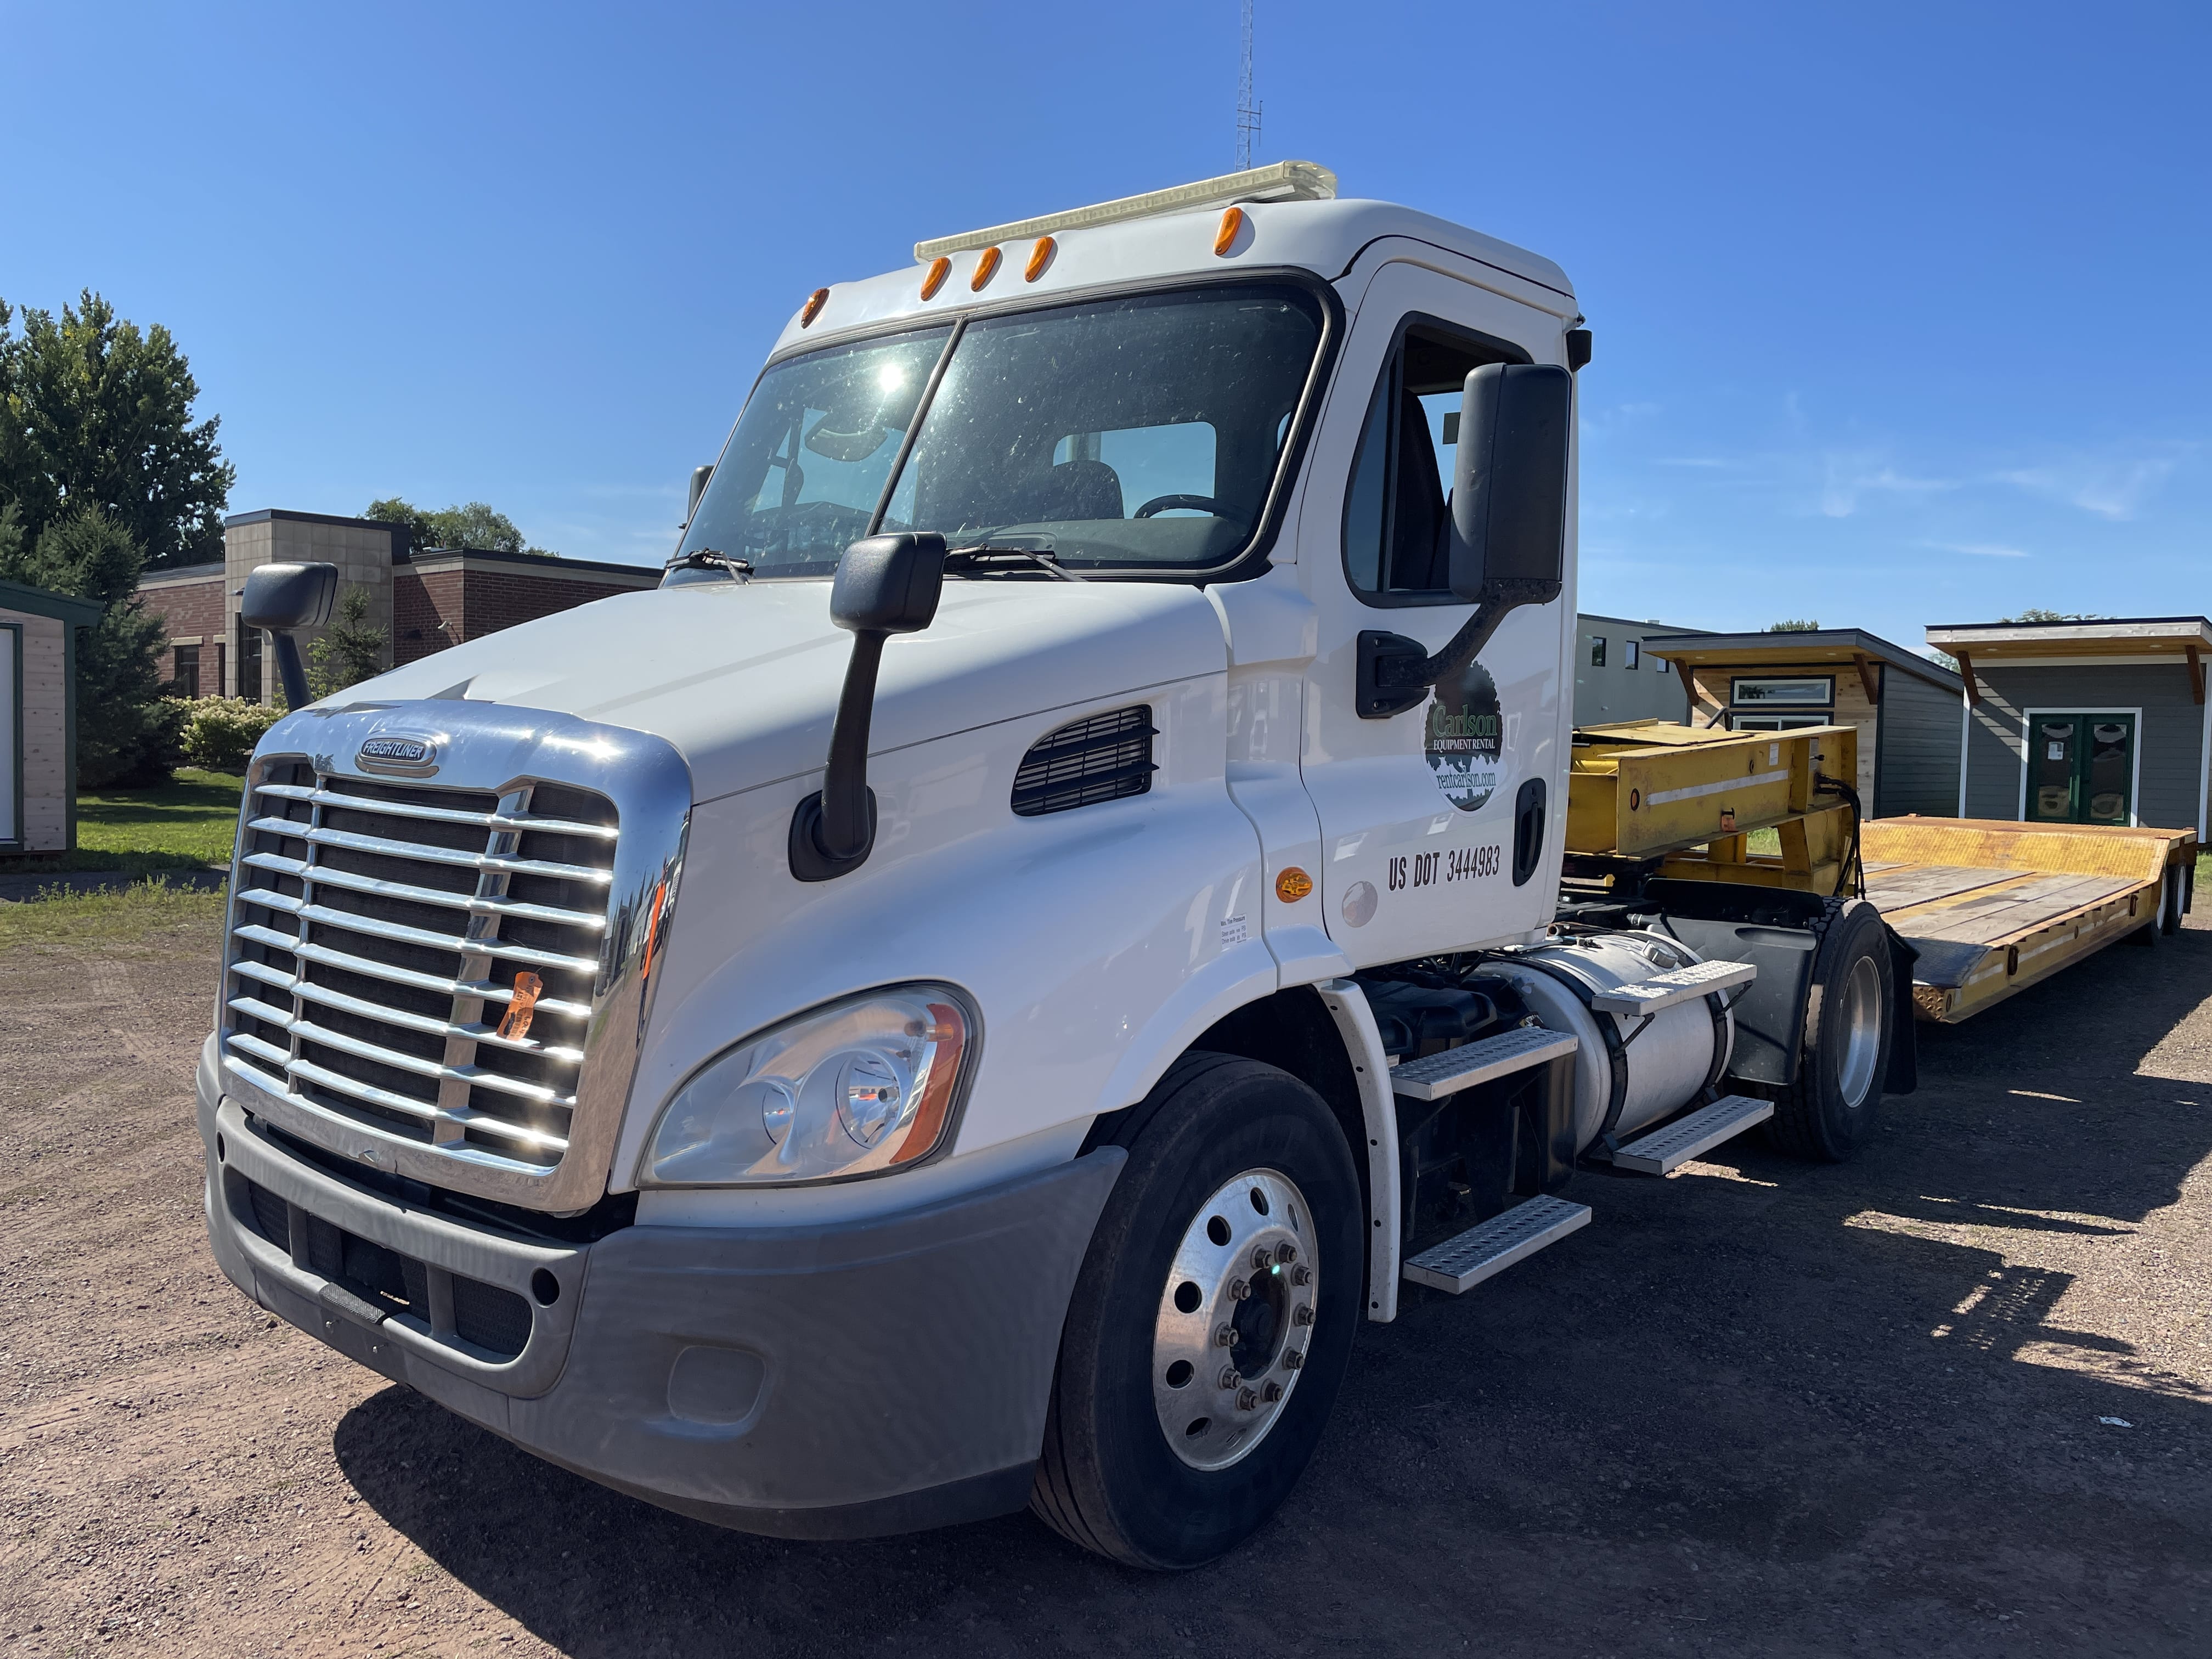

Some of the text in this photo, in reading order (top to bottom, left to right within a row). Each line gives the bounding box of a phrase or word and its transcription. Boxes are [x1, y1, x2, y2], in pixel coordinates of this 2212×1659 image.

[1433, 704, 1497, 737] Carlson
[363, 741, 424, 758] FREIGHTLINER
[1434, 738, 1495, 753] EQUIPMENT RENTAL
[1436, 766, 1496, 789] rentcarlson.com
[1389, 845, 1500, 891] US DOT 3444983
